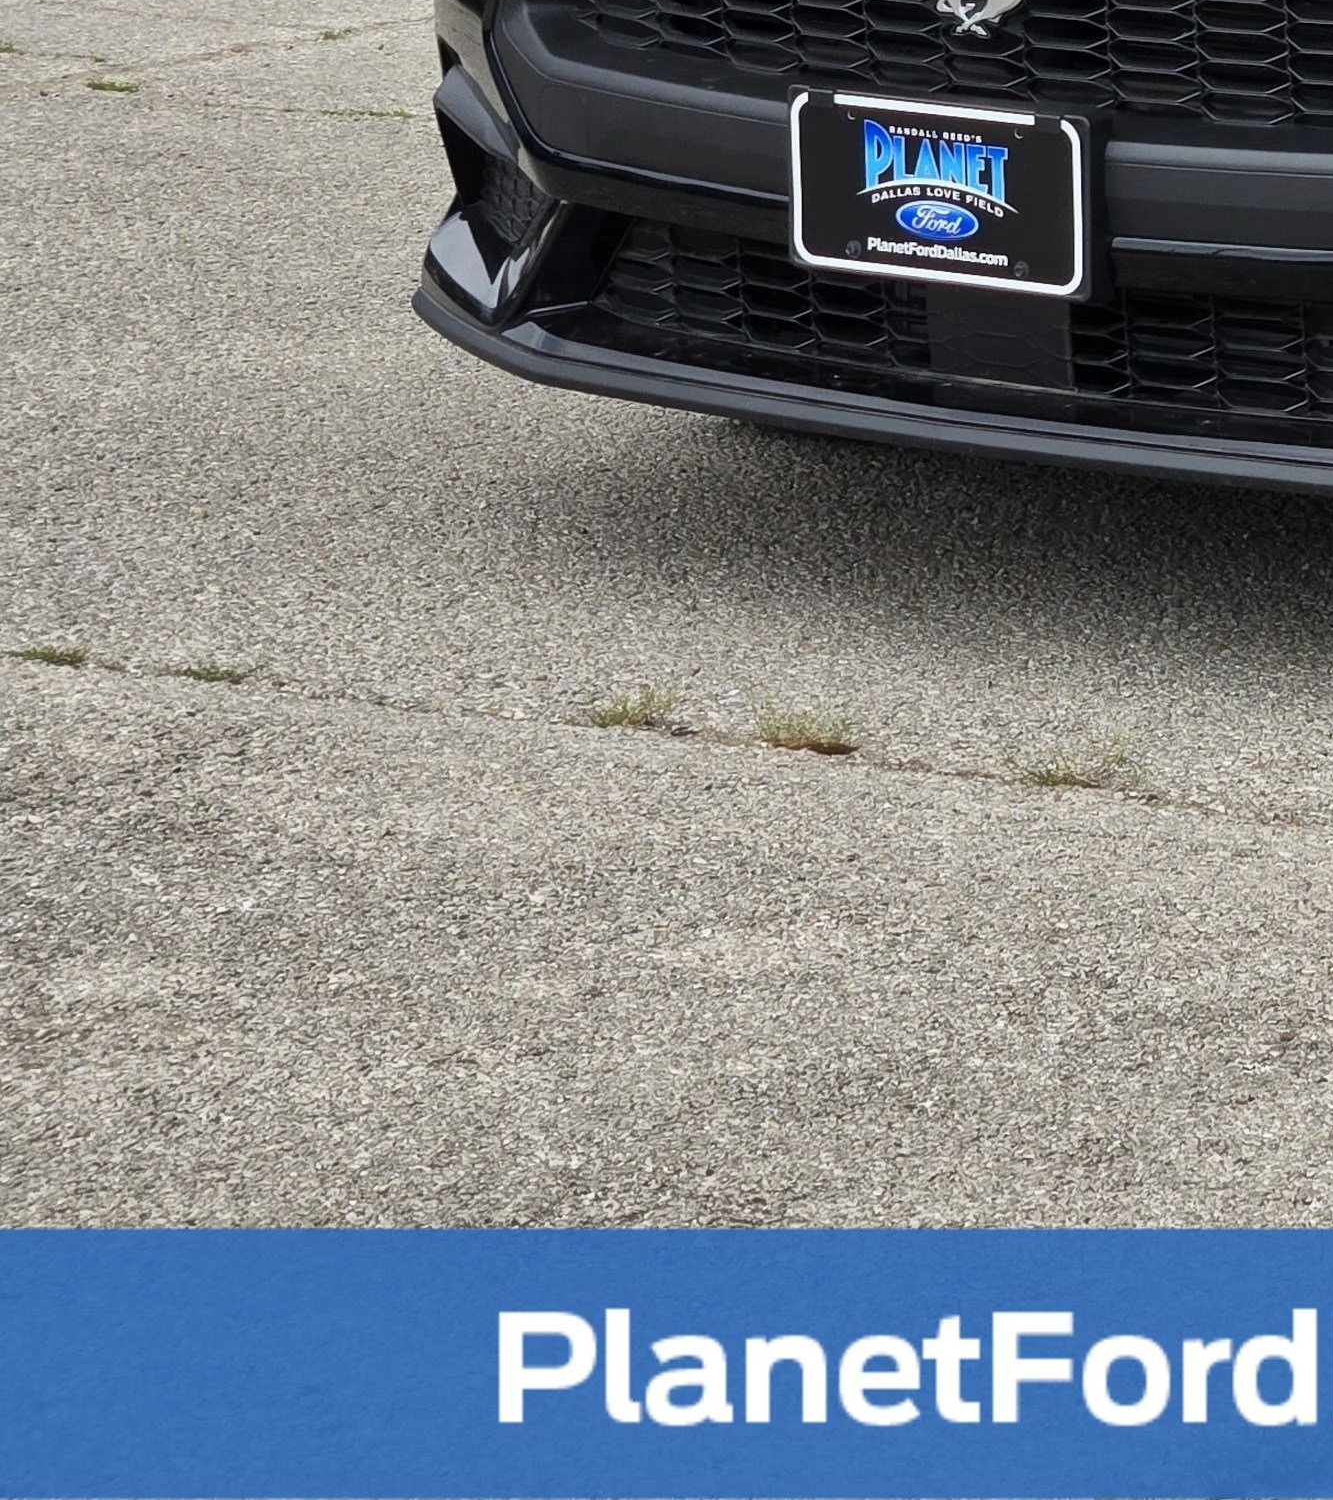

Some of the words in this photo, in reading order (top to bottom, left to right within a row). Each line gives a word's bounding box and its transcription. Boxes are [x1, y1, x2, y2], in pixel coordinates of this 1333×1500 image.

[864, 119, 1008, 203] PLANET
[871, 186, 921, 203] DALLAS
[926, 187, 960, 201] LOVE
[965, 195, 1004, 218] FIELD
[911, 207, 962, 235] Ford
[867, 237, 1008, 266] PlanetFordDallas.com
